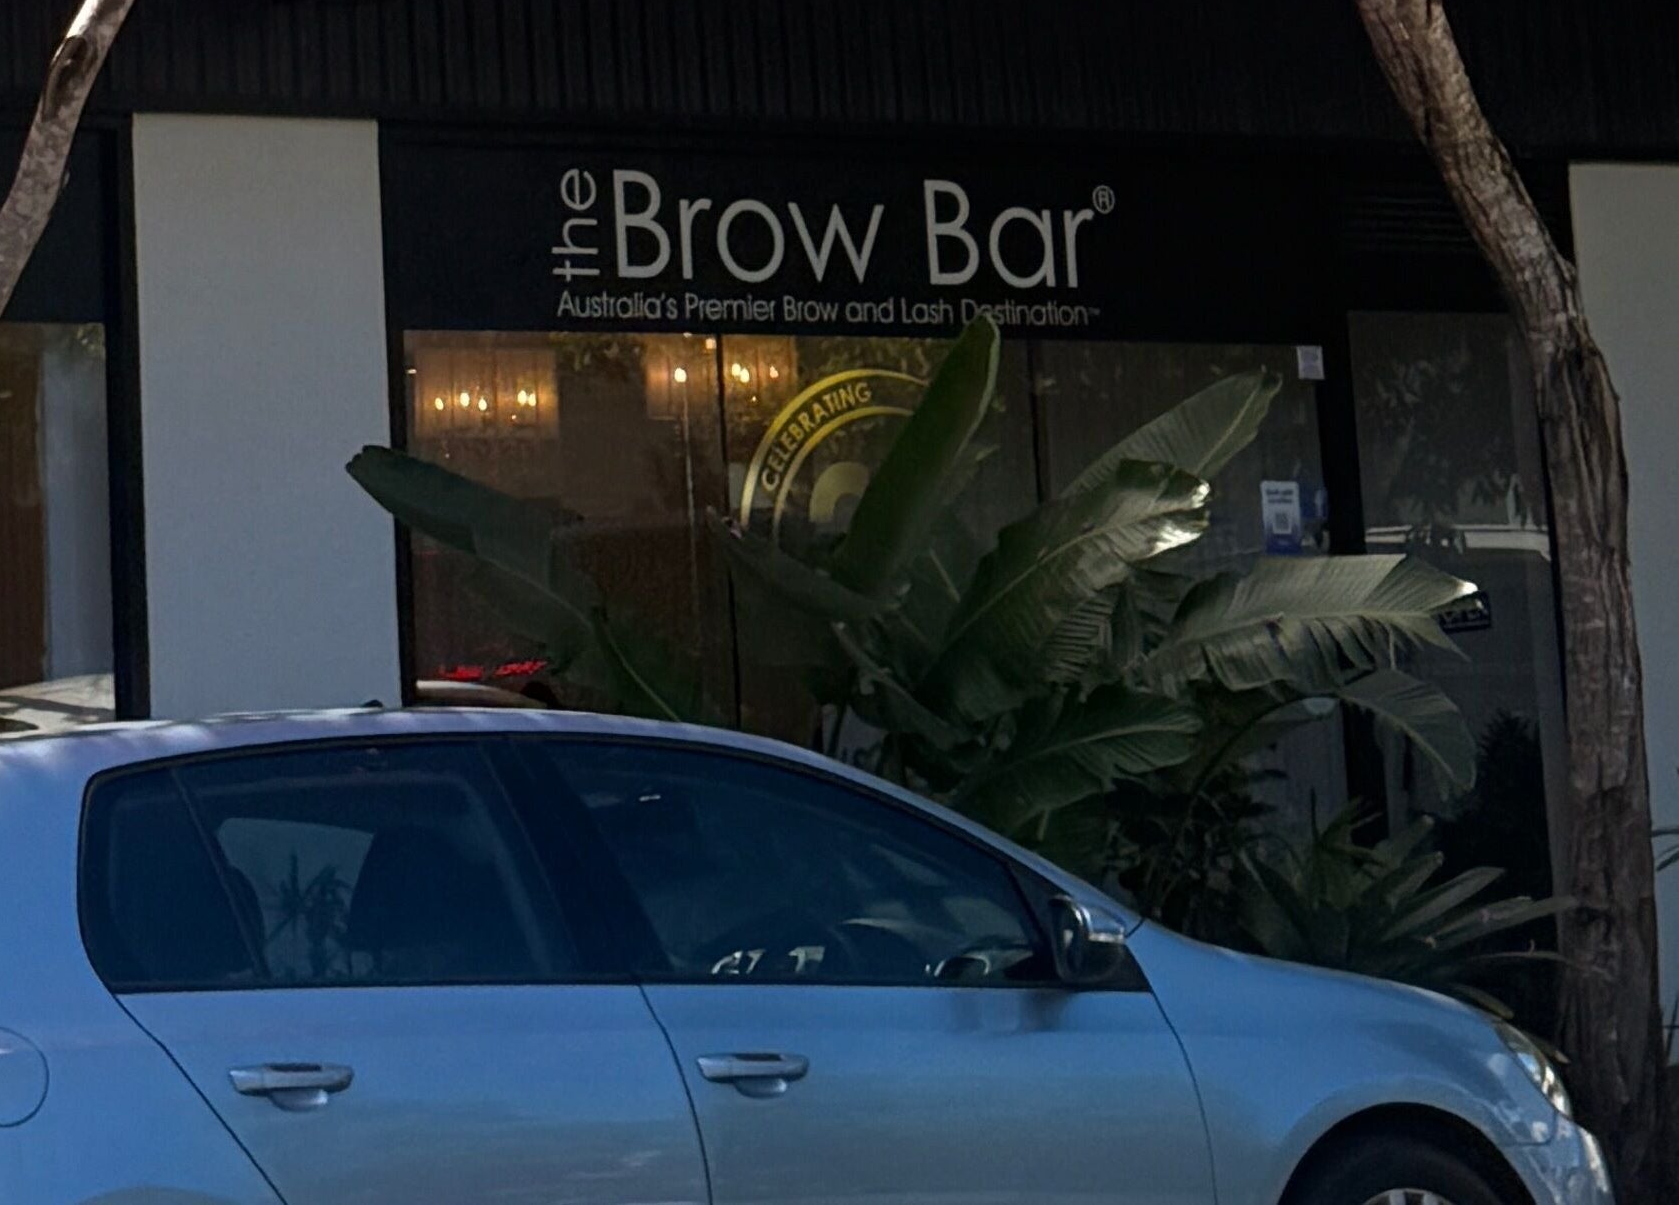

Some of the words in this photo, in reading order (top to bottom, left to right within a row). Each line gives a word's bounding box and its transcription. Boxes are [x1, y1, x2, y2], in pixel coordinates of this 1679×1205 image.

[551, 168, 600, 282] the
[613, 169, 884, 283] Brow
[557, 290, 678, 320] Australia's
[684, 292, 776, 322] Premier
[782, 295, 839, 323] Brow
[845, 296, 895, 324] and
[901, 297, 954, 325] Lash
[760, 381, 873, 492] CELEBRATING
